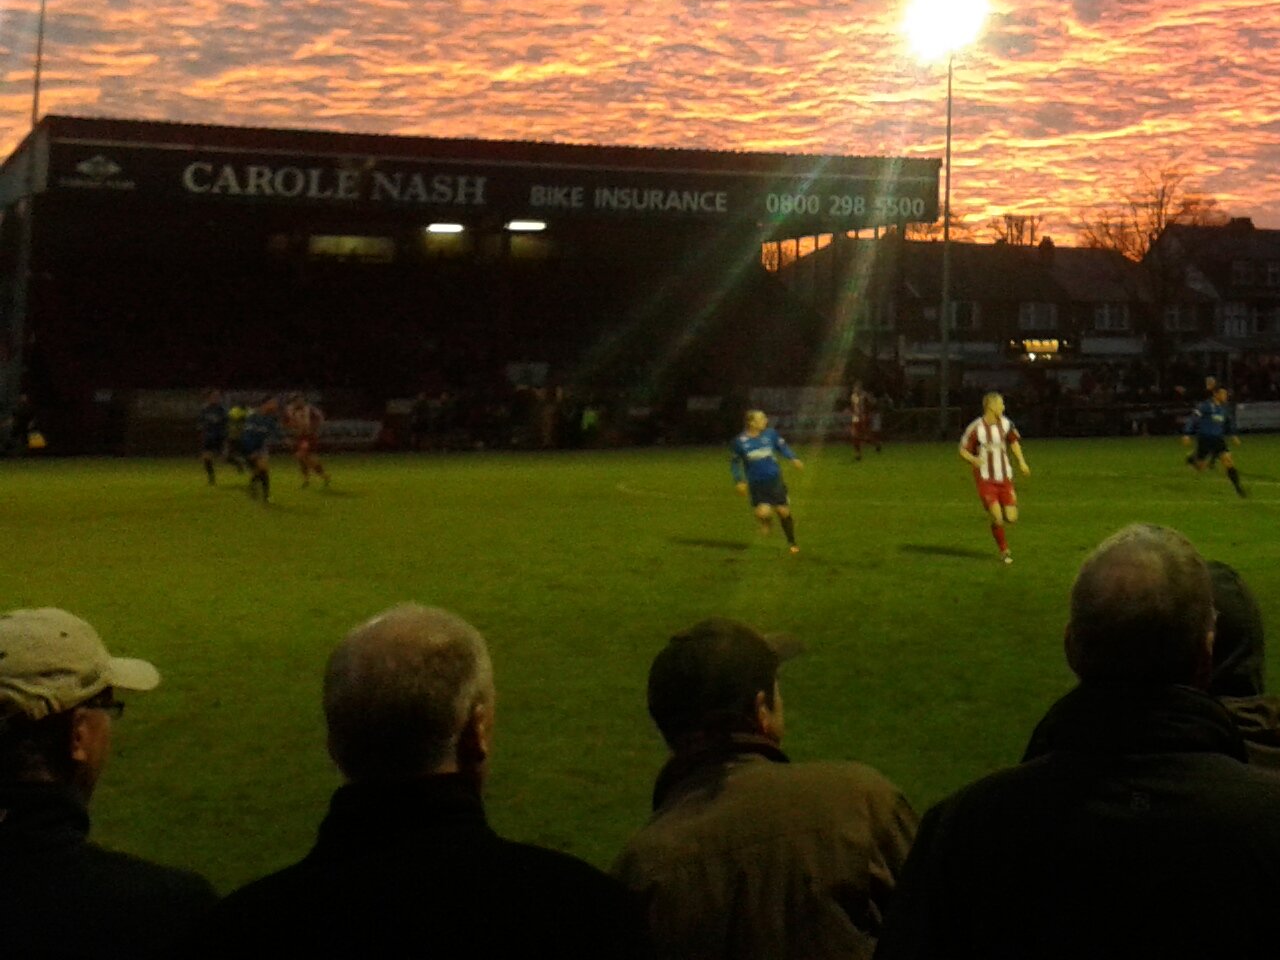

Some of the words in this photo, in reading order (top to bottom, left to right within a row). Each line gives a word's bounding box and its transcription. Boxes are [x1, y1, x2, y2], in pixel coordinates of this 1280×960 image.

[182, 160, 361, 200] CAROLE
[370, 171, 488, 206] NASH
[529, 185, 584, 208] BIKE
[594, 187, 728, 213] INSURANCE
[766, 193, 820, 216] 0800
[829, 195, 865, 217] 298
[874, 196, 925, 218] 5500
